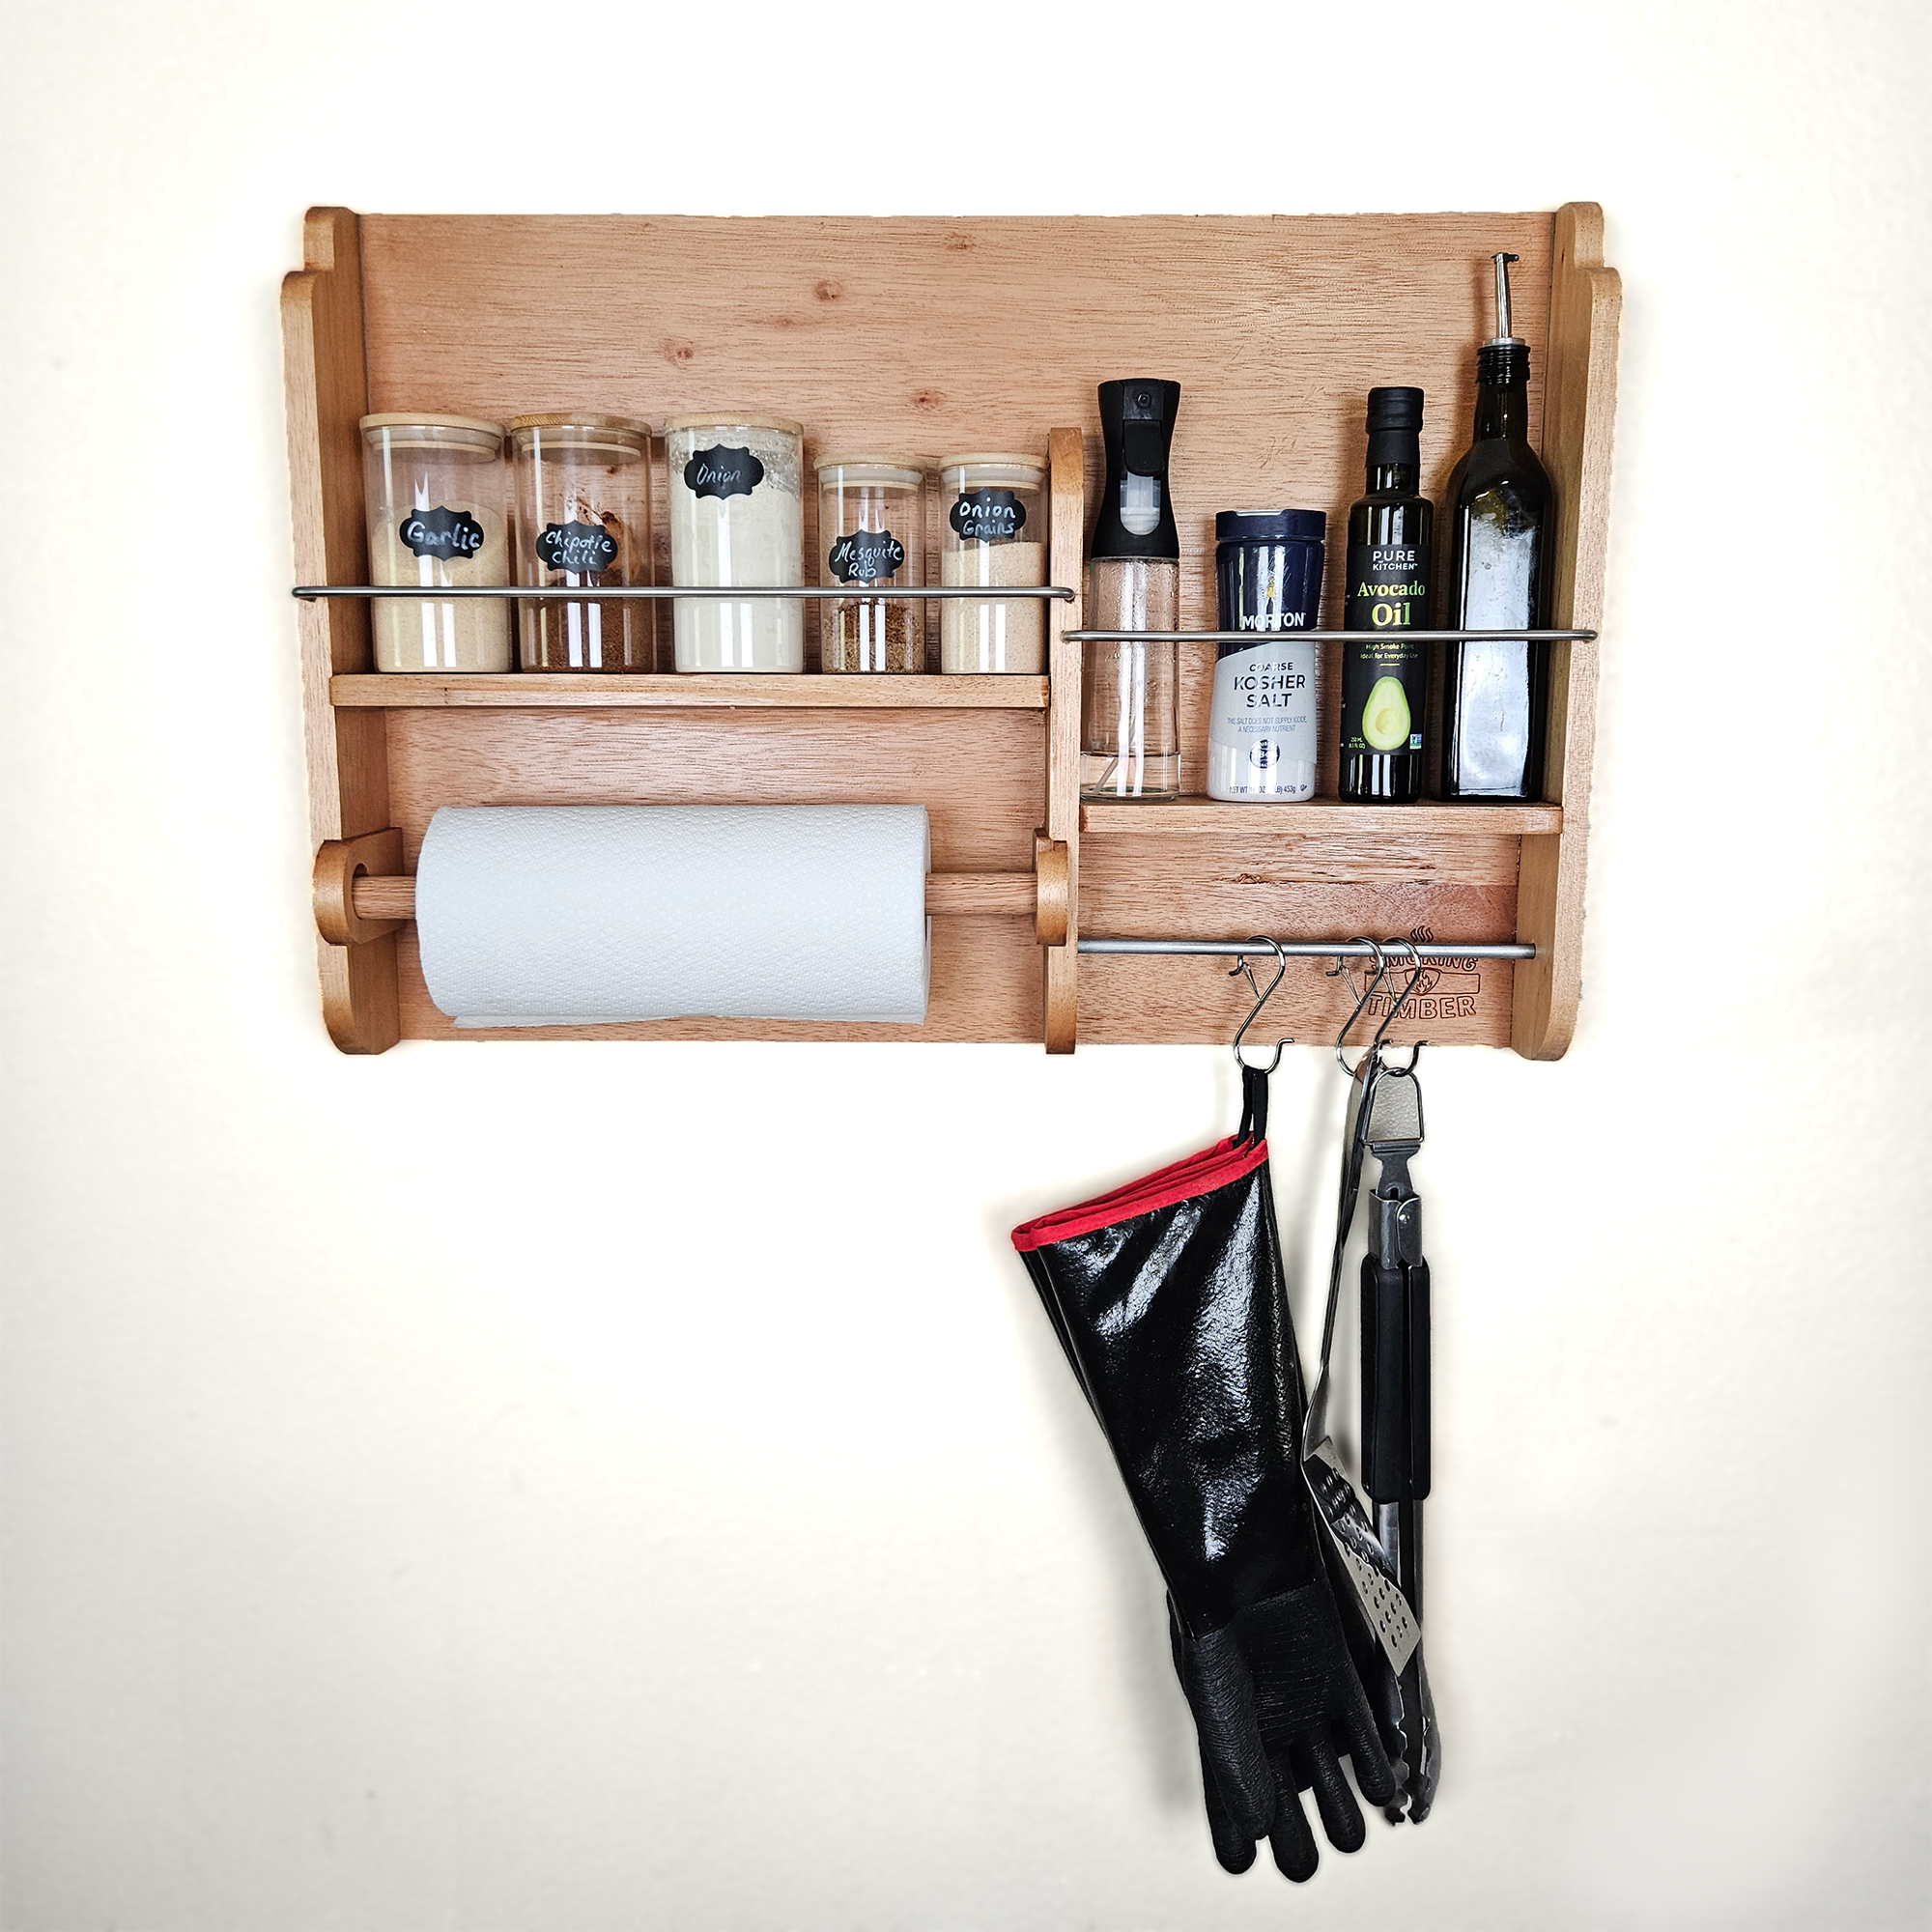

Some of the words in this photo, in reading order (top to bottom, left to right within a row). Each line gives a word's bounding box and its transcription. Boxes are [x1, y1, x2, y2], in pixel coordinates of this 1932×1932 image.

[696, 463, 741, 485] Onion
[959, 497, 1016, 519] Onion
[408, 522, 480, 550] Garlic
[963, 520, 1014, 537] Grains
[546, 530, 612, 554] Chipotle
[552, 550, 598, 565] Chili
[835, 541, 902, 566] Mesquite
[1373, 551, 1415, 561] PURE
[848, 560, 877, 578] Rub
[1357, 581, 1426, 597] Avocado
[1372, 603, 1410, 626] Oil
[1249, 662, 1293, 672] COARSE
[1234, 674, 1306, 690] KOSHER
[1246, 694, 1293, 708] SALT
[1368, 995, 1477, 1019] TIMBER
